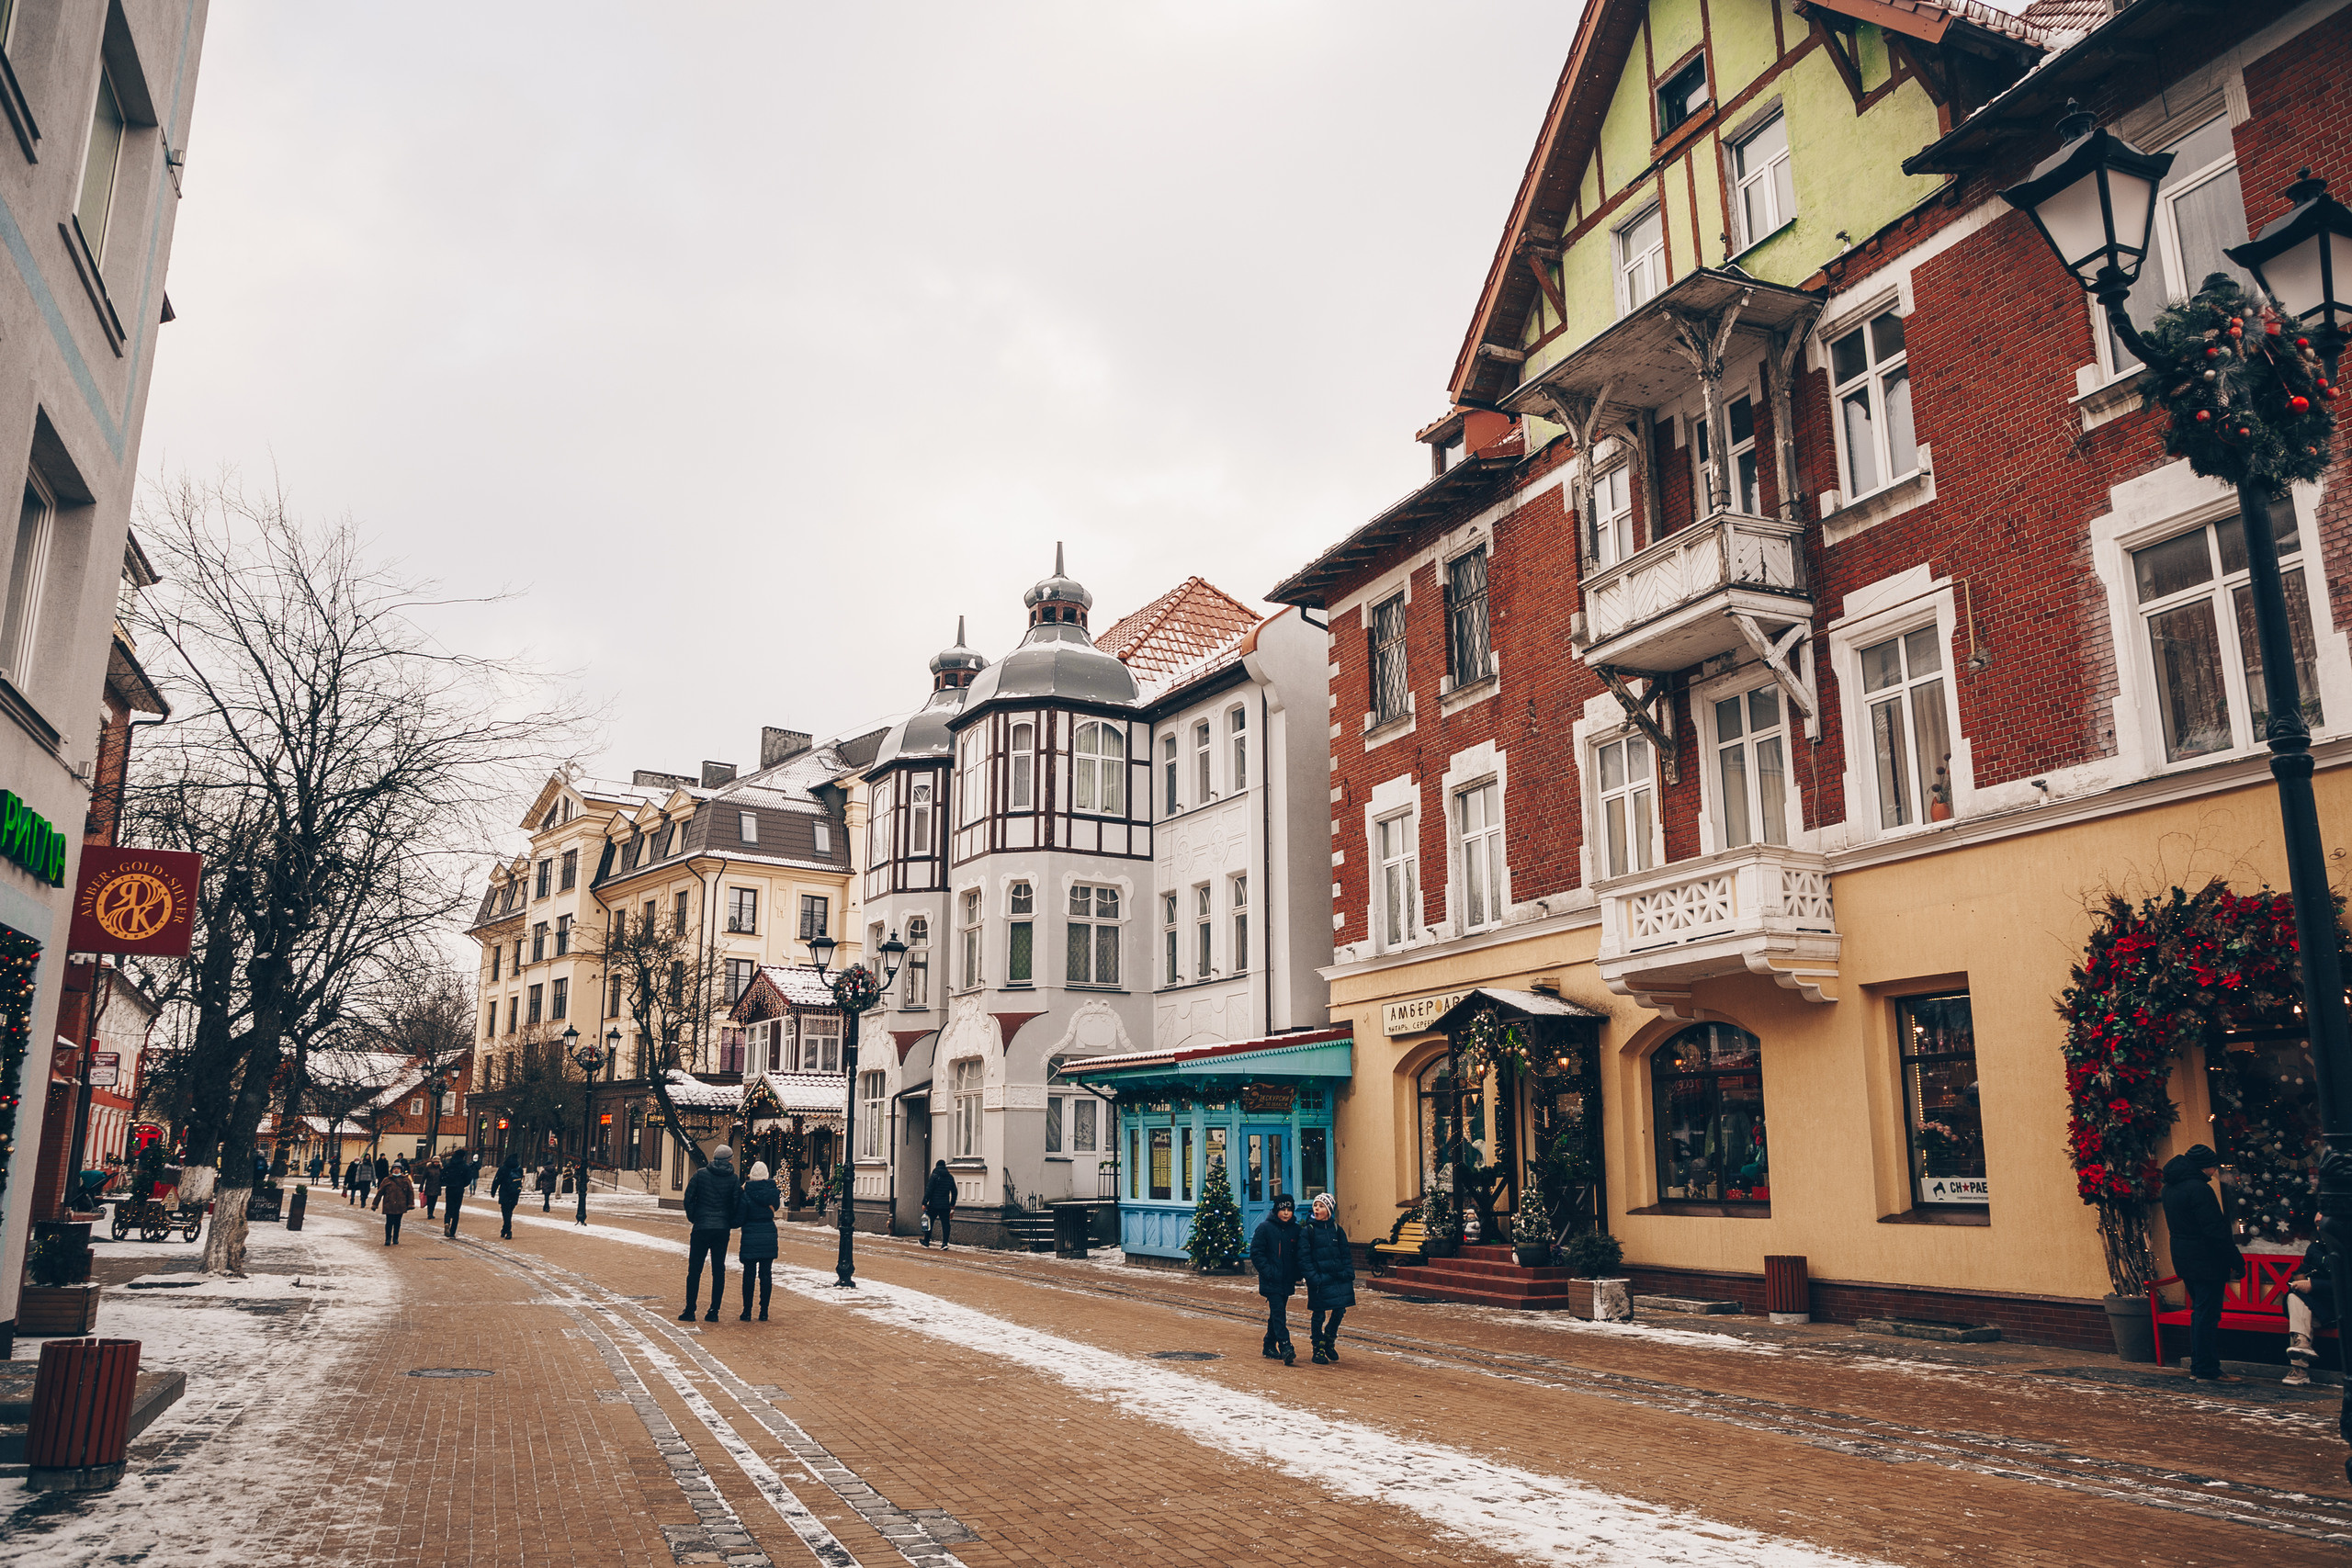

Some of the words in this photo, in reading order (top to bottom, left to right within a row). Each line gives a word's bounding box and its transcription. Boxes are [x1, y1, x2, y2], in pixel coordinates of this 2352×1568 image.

[81, 872, 111, 917] AMBER
[119, 861, 163, 874] GOLD
[168, 877, 187, 923] SILVER
[1390, 1000, 1433, 1021] АМБЕР
